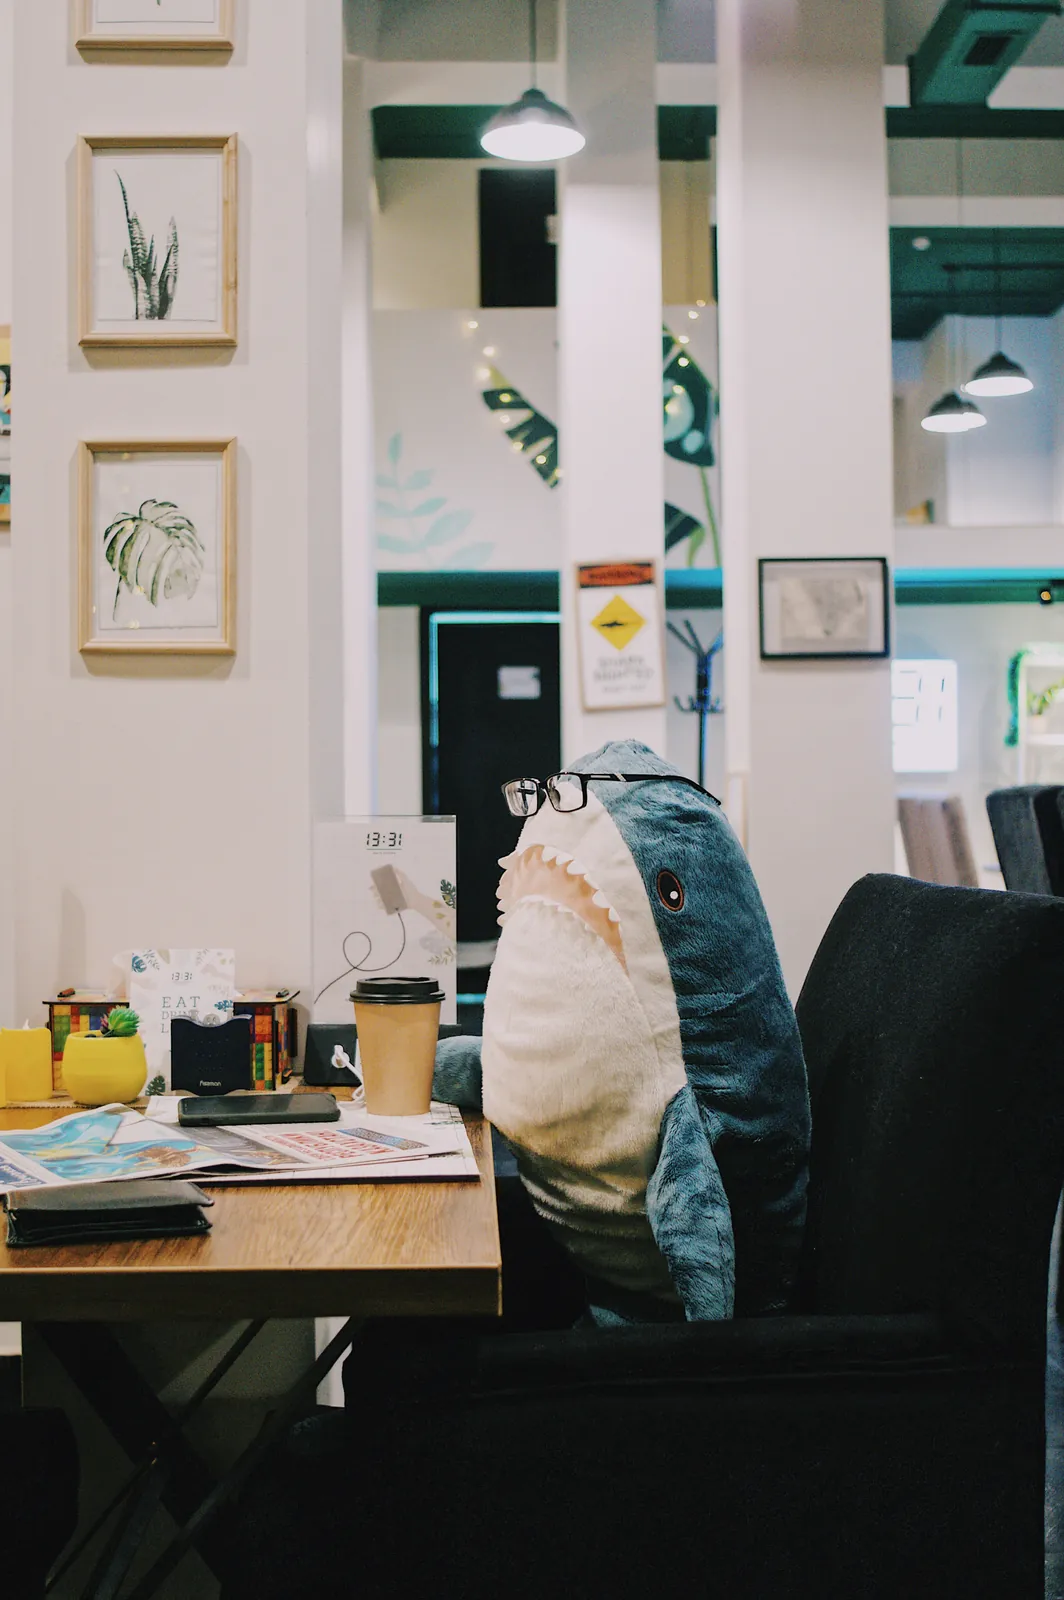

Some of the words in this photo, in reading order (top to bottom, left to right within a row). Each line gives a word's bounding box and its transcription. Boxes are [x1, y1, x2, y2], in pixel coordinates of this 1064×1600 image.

[366, 832, 403, 847] 13:31
[171, 972, 193, 981] 13:31
[162, 996, 200, 1009] EAT
